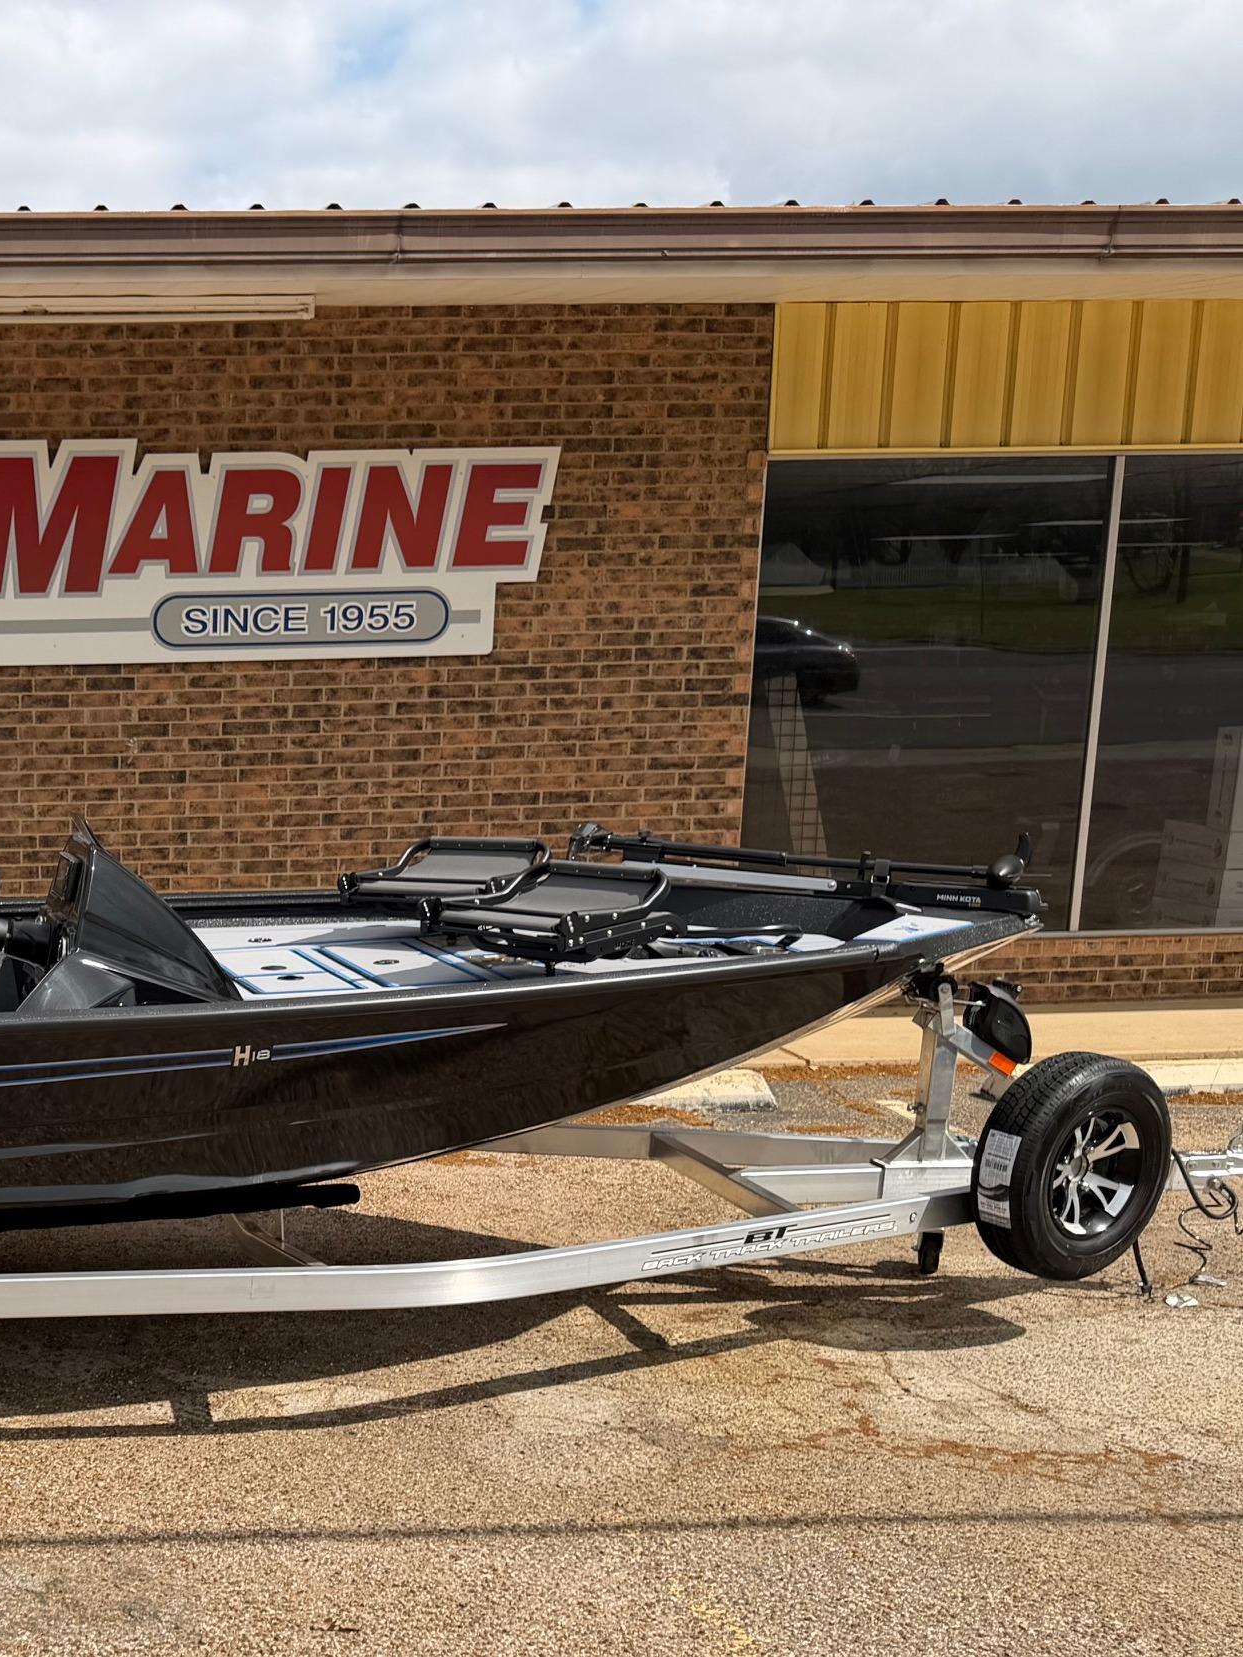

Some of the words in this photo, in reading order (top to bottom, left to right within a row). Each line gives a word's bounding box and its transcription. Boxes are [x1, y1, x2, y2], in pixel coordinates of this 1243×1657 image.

[182, 604, 308, 637] SINCE
[320, 602, 417, 633] 1955
[936, 893, 959, 902] MINN
[959, 895, 982, 904] KOTA
[641, 1252, 706, 1272] BACK
[710, 1238, 788, 1260] TRACK
[789, 1220, 896, 1247] TRAILERS
